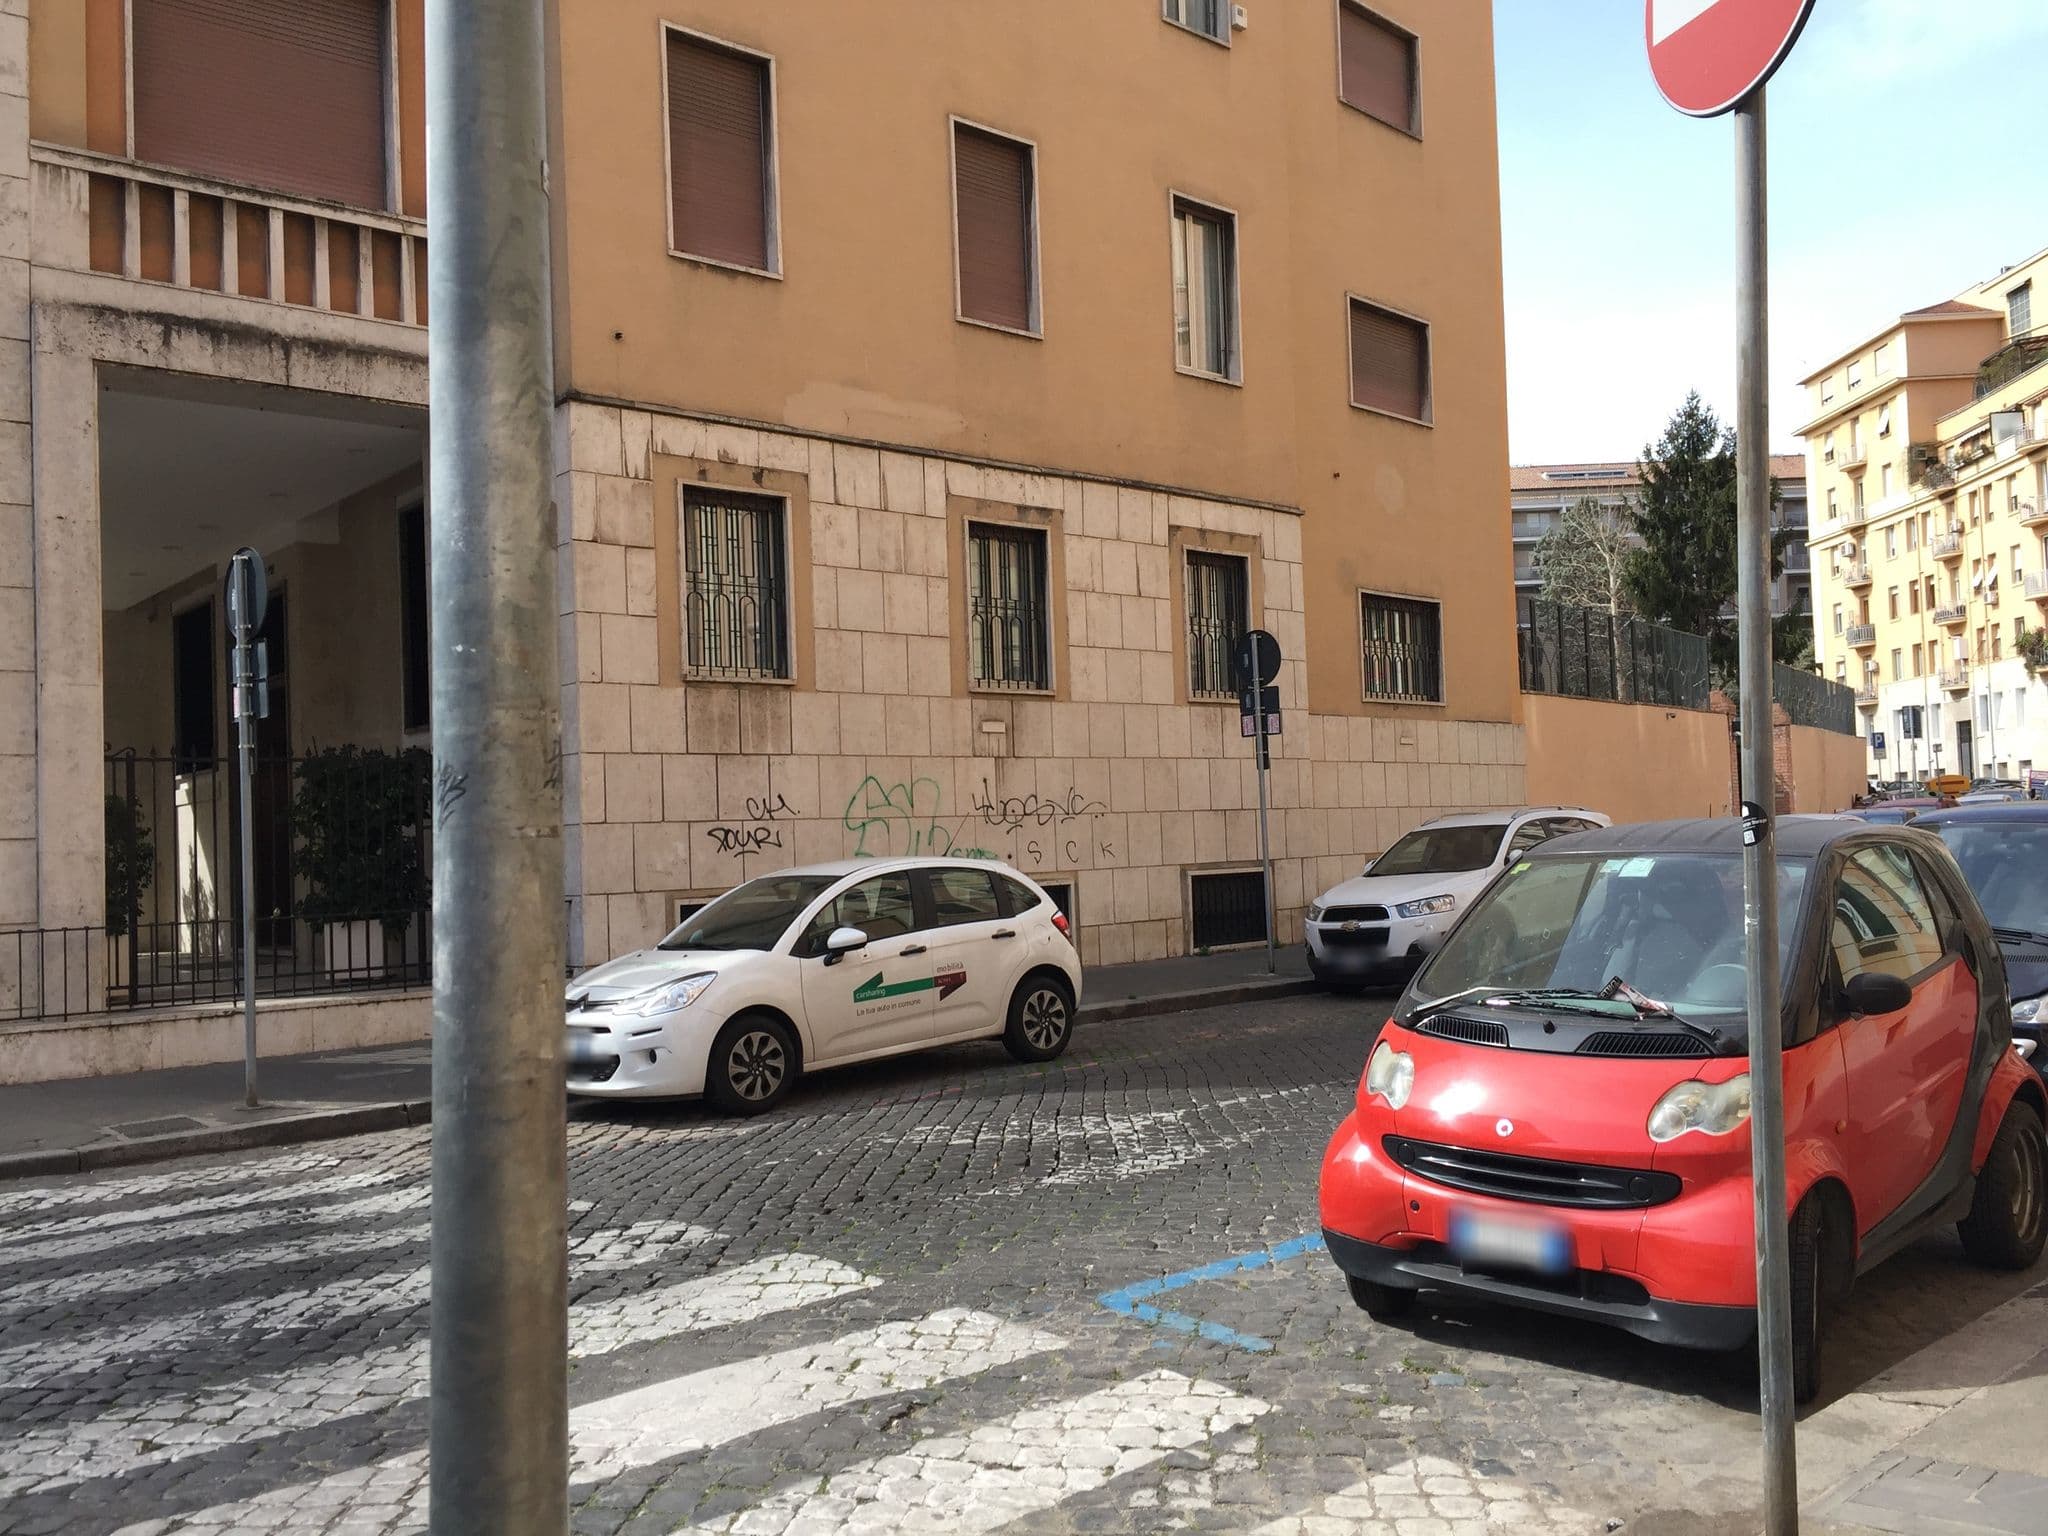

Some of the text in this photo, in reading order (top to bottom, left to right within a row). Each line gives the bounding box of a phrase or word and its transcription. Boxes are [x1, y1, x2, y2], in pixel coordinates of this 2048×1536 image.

[856, 988, 886, 1000] carsharing
[856, 1009, 865, 1017] La
[866, 1007, 876, 1015] tua
[877, 1003, 891, 1012] auto
[898, 999, 921, 1009] comune
